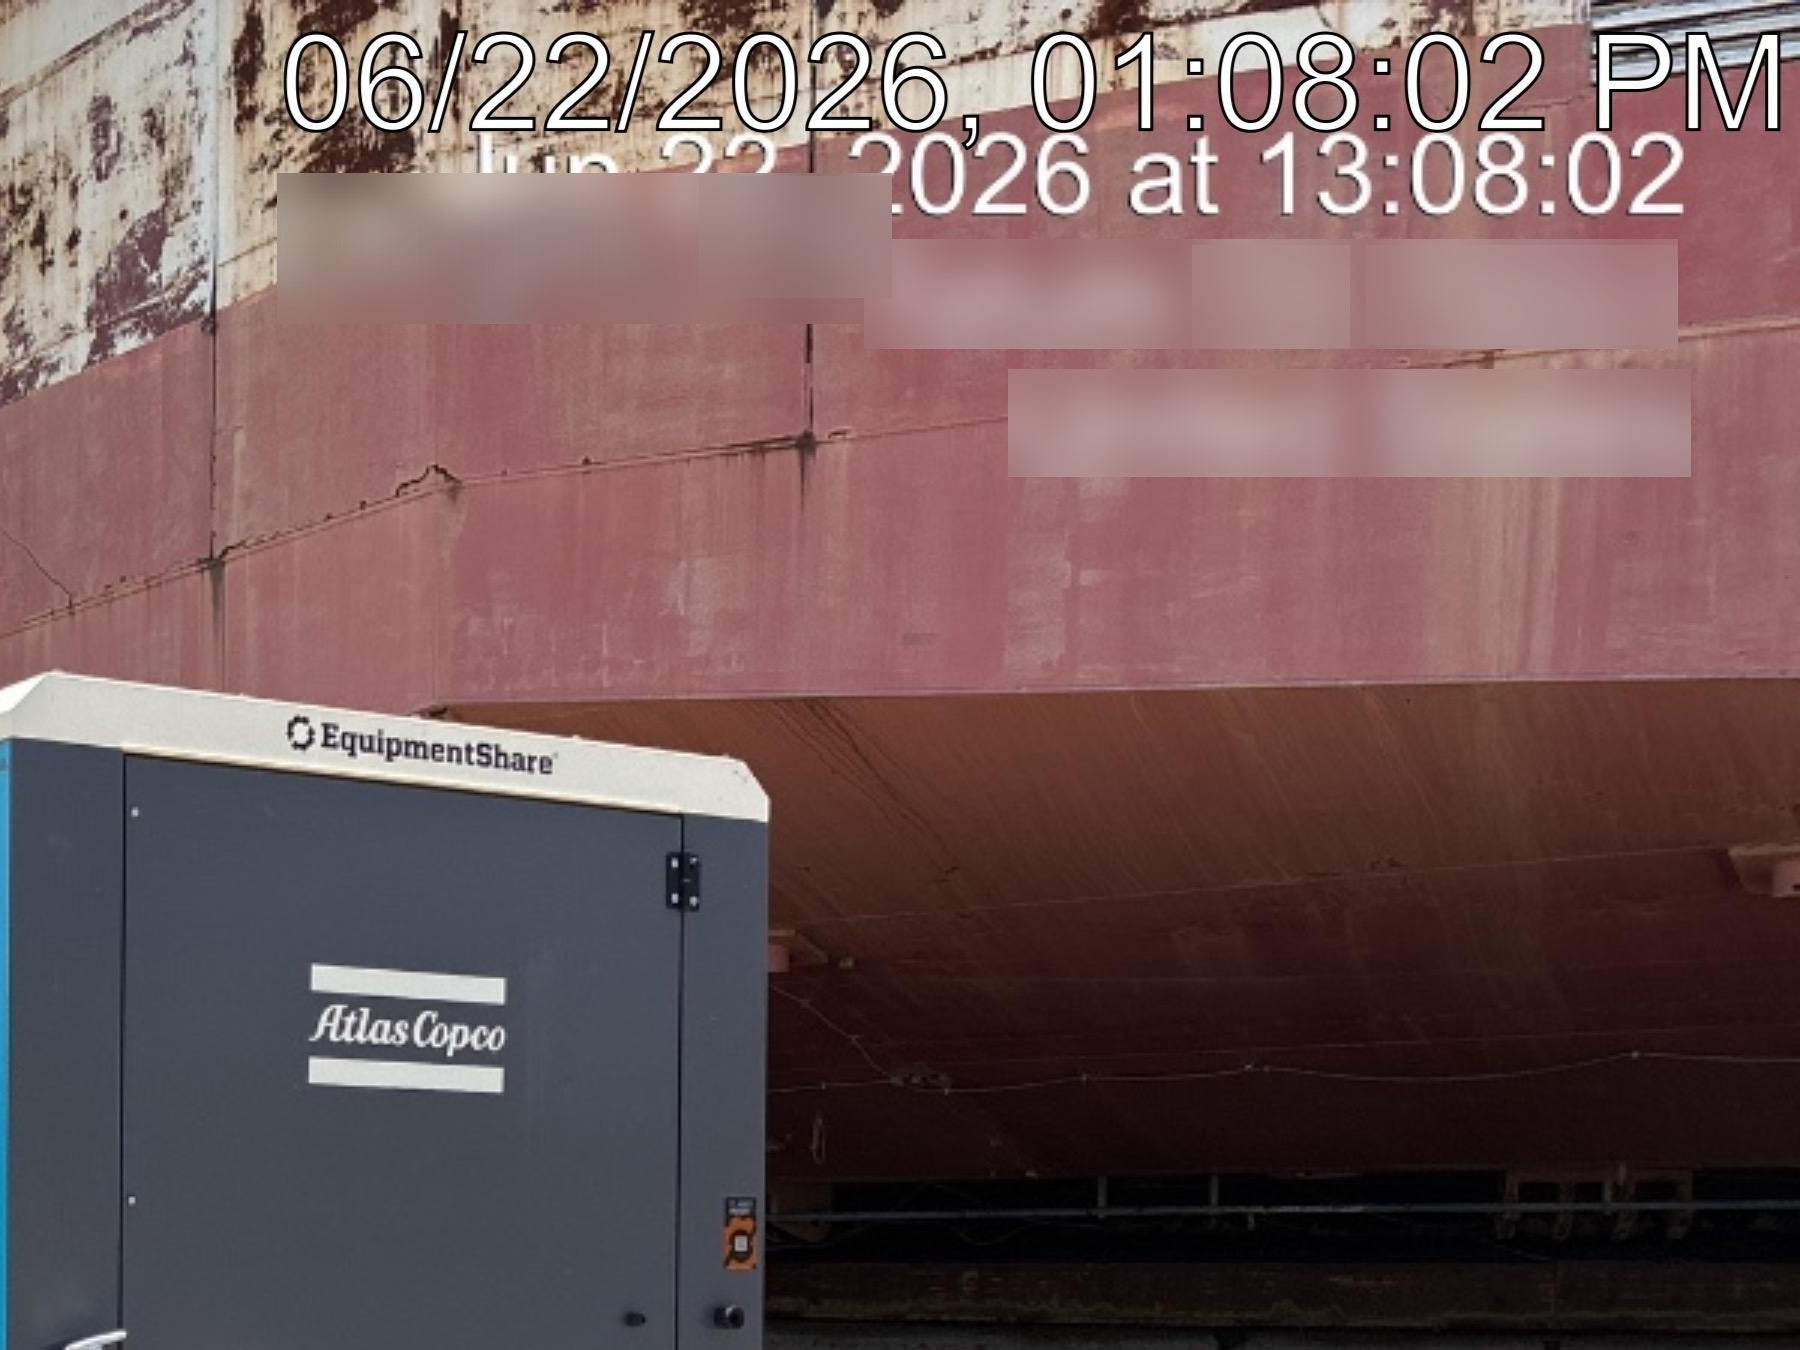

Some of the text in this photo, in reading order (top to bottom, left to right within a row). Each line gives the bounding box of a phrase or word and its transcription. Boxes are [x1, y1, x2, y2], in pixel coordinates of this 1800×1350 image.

[320, 722, 553, 775] EquipmentShare
[309, 1003, 505, 1057] Atlas Copco
